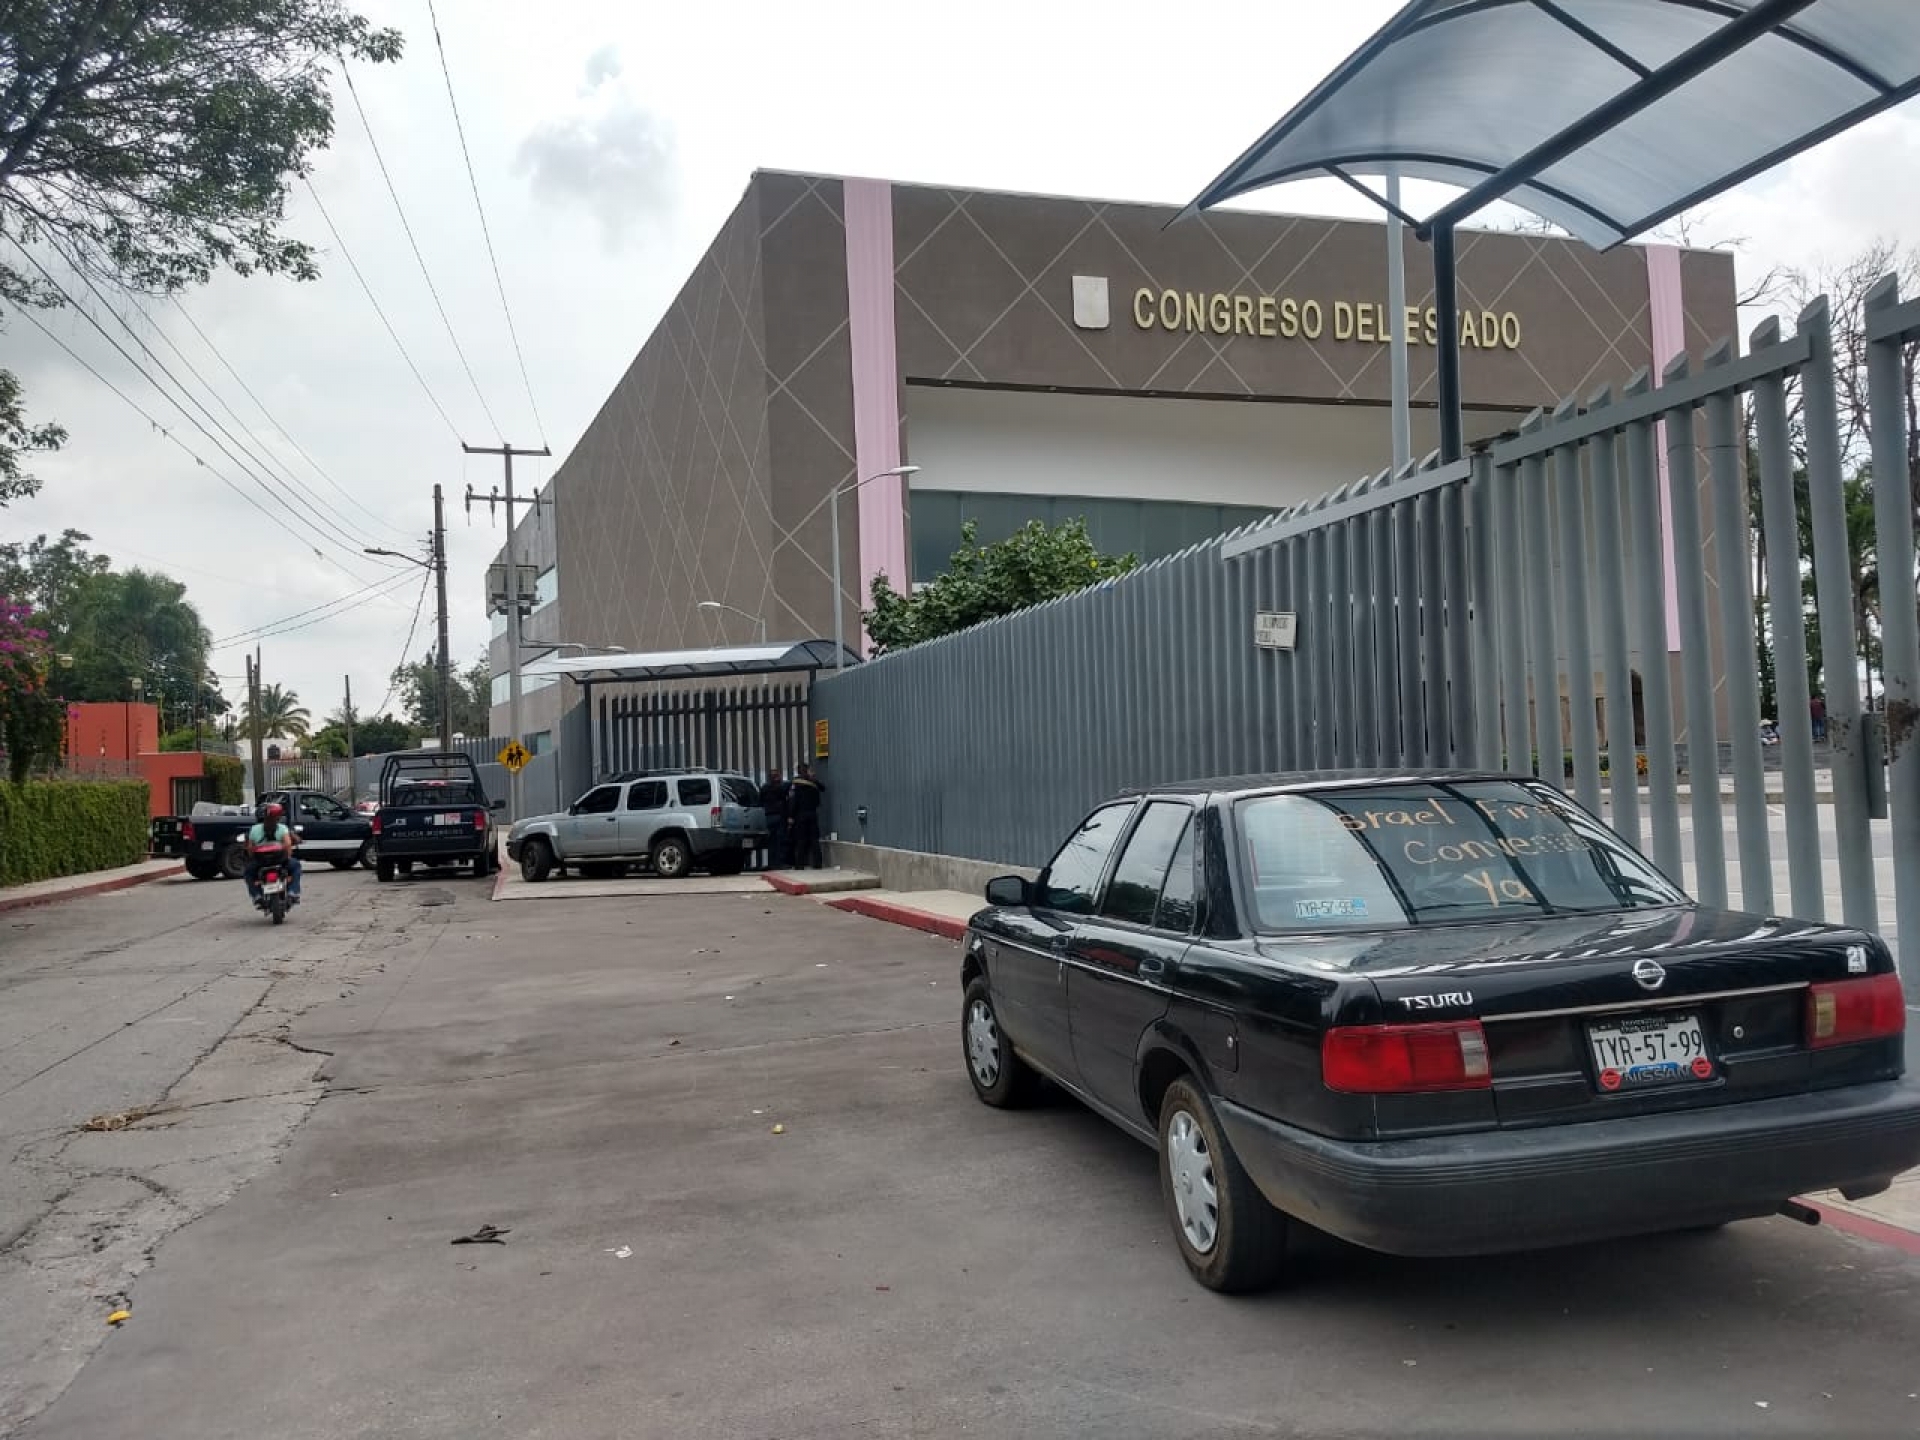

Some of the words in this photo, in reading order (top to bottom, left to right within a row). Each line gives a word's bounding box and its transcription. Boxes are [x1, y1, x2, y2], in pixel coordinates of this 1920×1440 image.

[1133, 287, 1323, 340] CONGRESO
[1334, 300, 1392, 342] DEL
[1404, 306, 1521, 349] ESADO
[1337, 797, 1455, 830] srael
[1463, 870, 1533, 908] Ya
[1398, 990, 1474, 1011] TSURU
[1594, 1029, 1702, 1067] TYR-57-99
[1621, 1064, 1692, 1082] NISSAN
